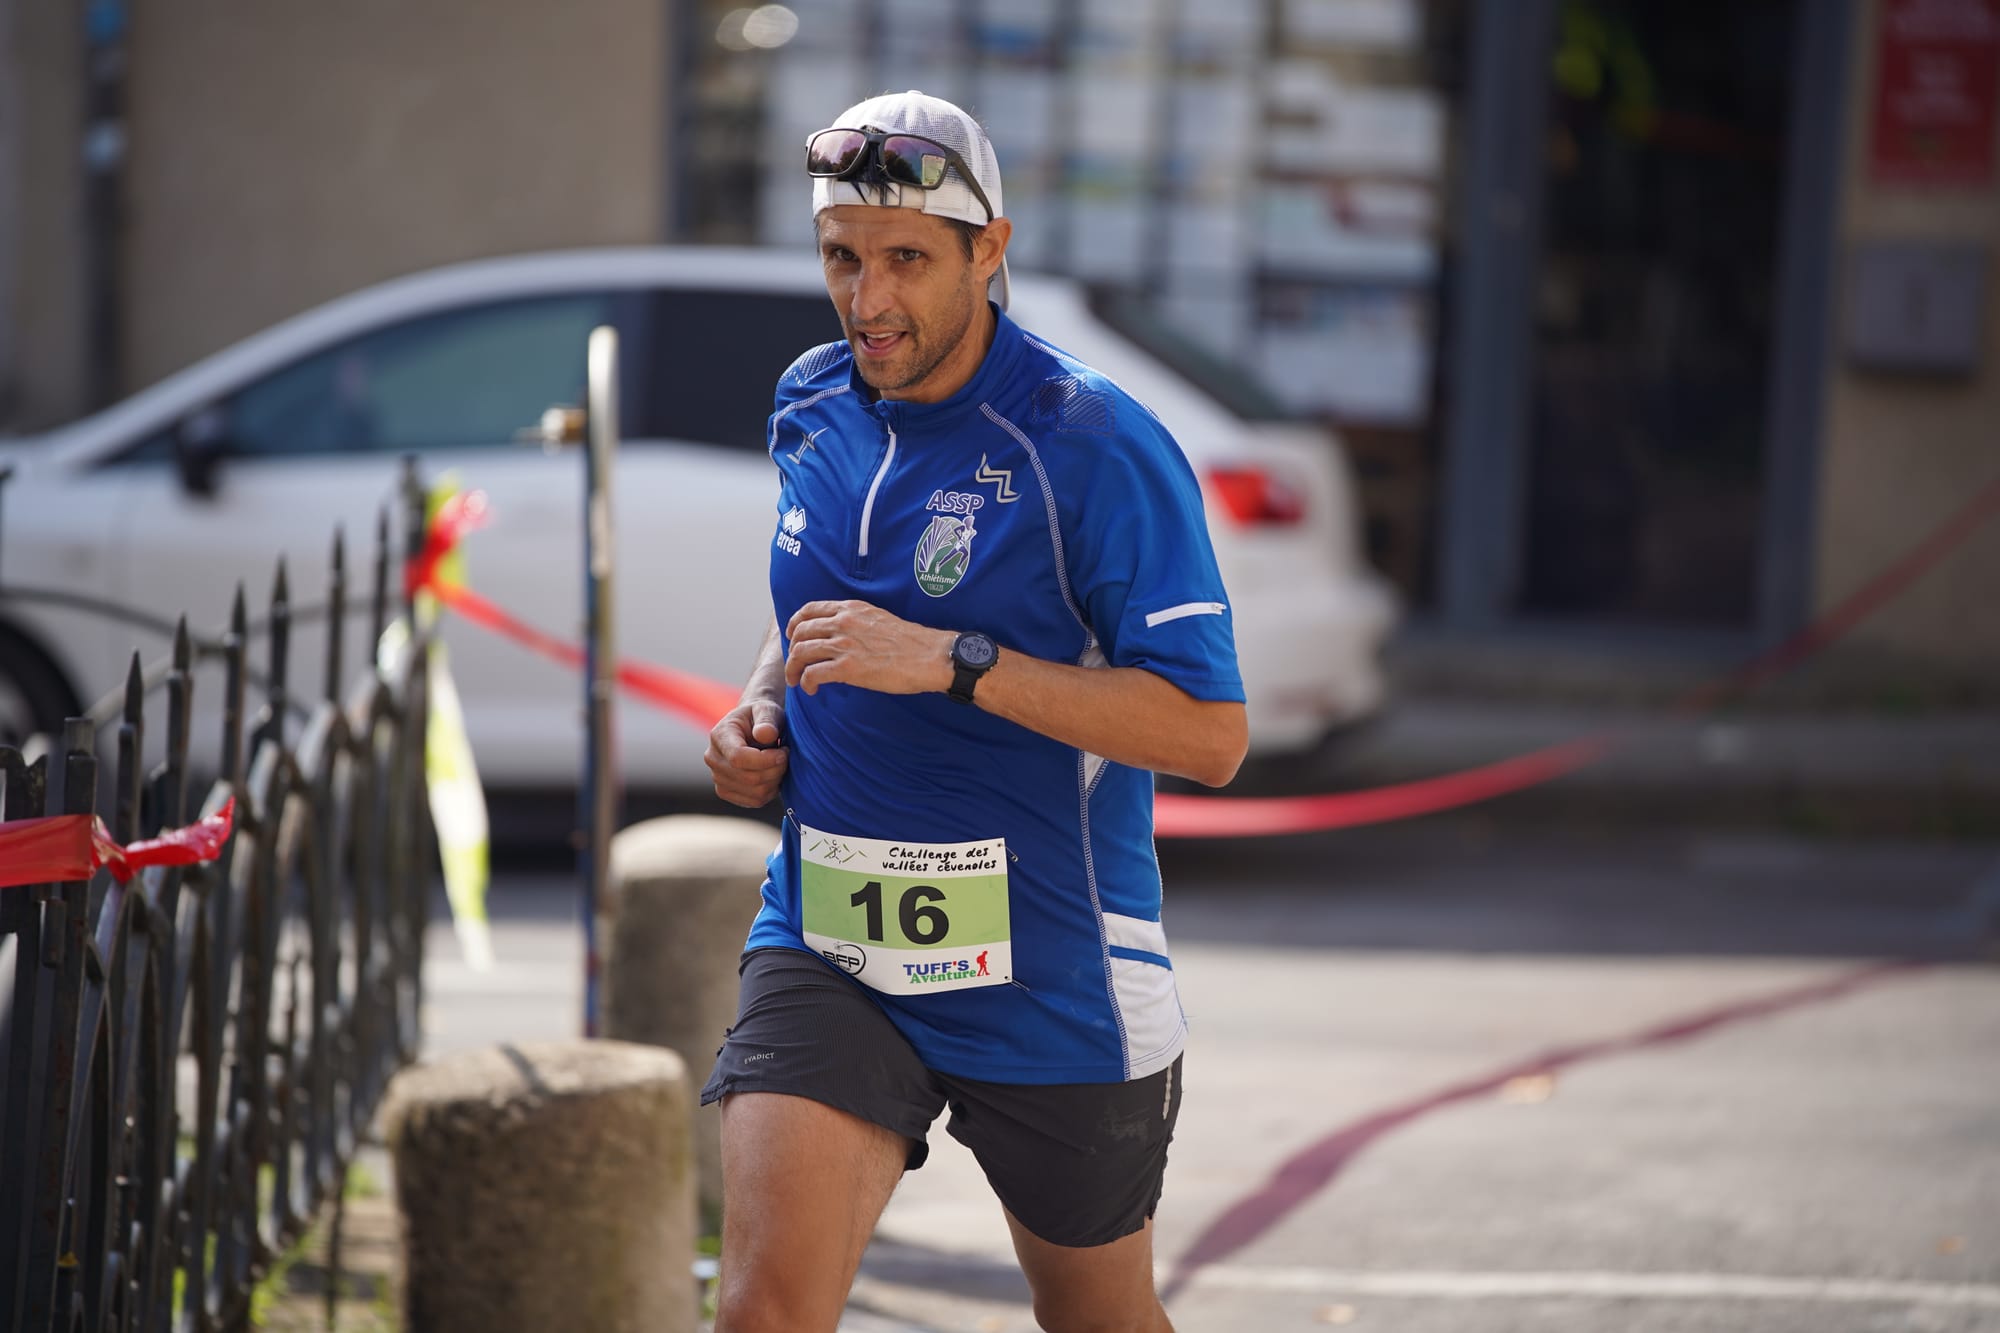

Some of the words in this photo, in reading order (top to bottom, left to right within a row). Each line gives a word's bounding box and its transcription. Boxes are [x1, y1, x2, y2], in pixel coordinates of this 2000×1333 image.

[926, 489, 984, 515] ASSP
[919, 573, 956, 585] Athlétisme
[889, 847, 957, 863] Challenge
[966, 847, 989, 858] des
[882, 860, 928, 872] vallées
[937, 860, 997, 872] cévenoles
[850, 881, 949, 945] 16
[903, 960, 969, 976] TUFF'S
[909, 969, 977, 984] Aventure
